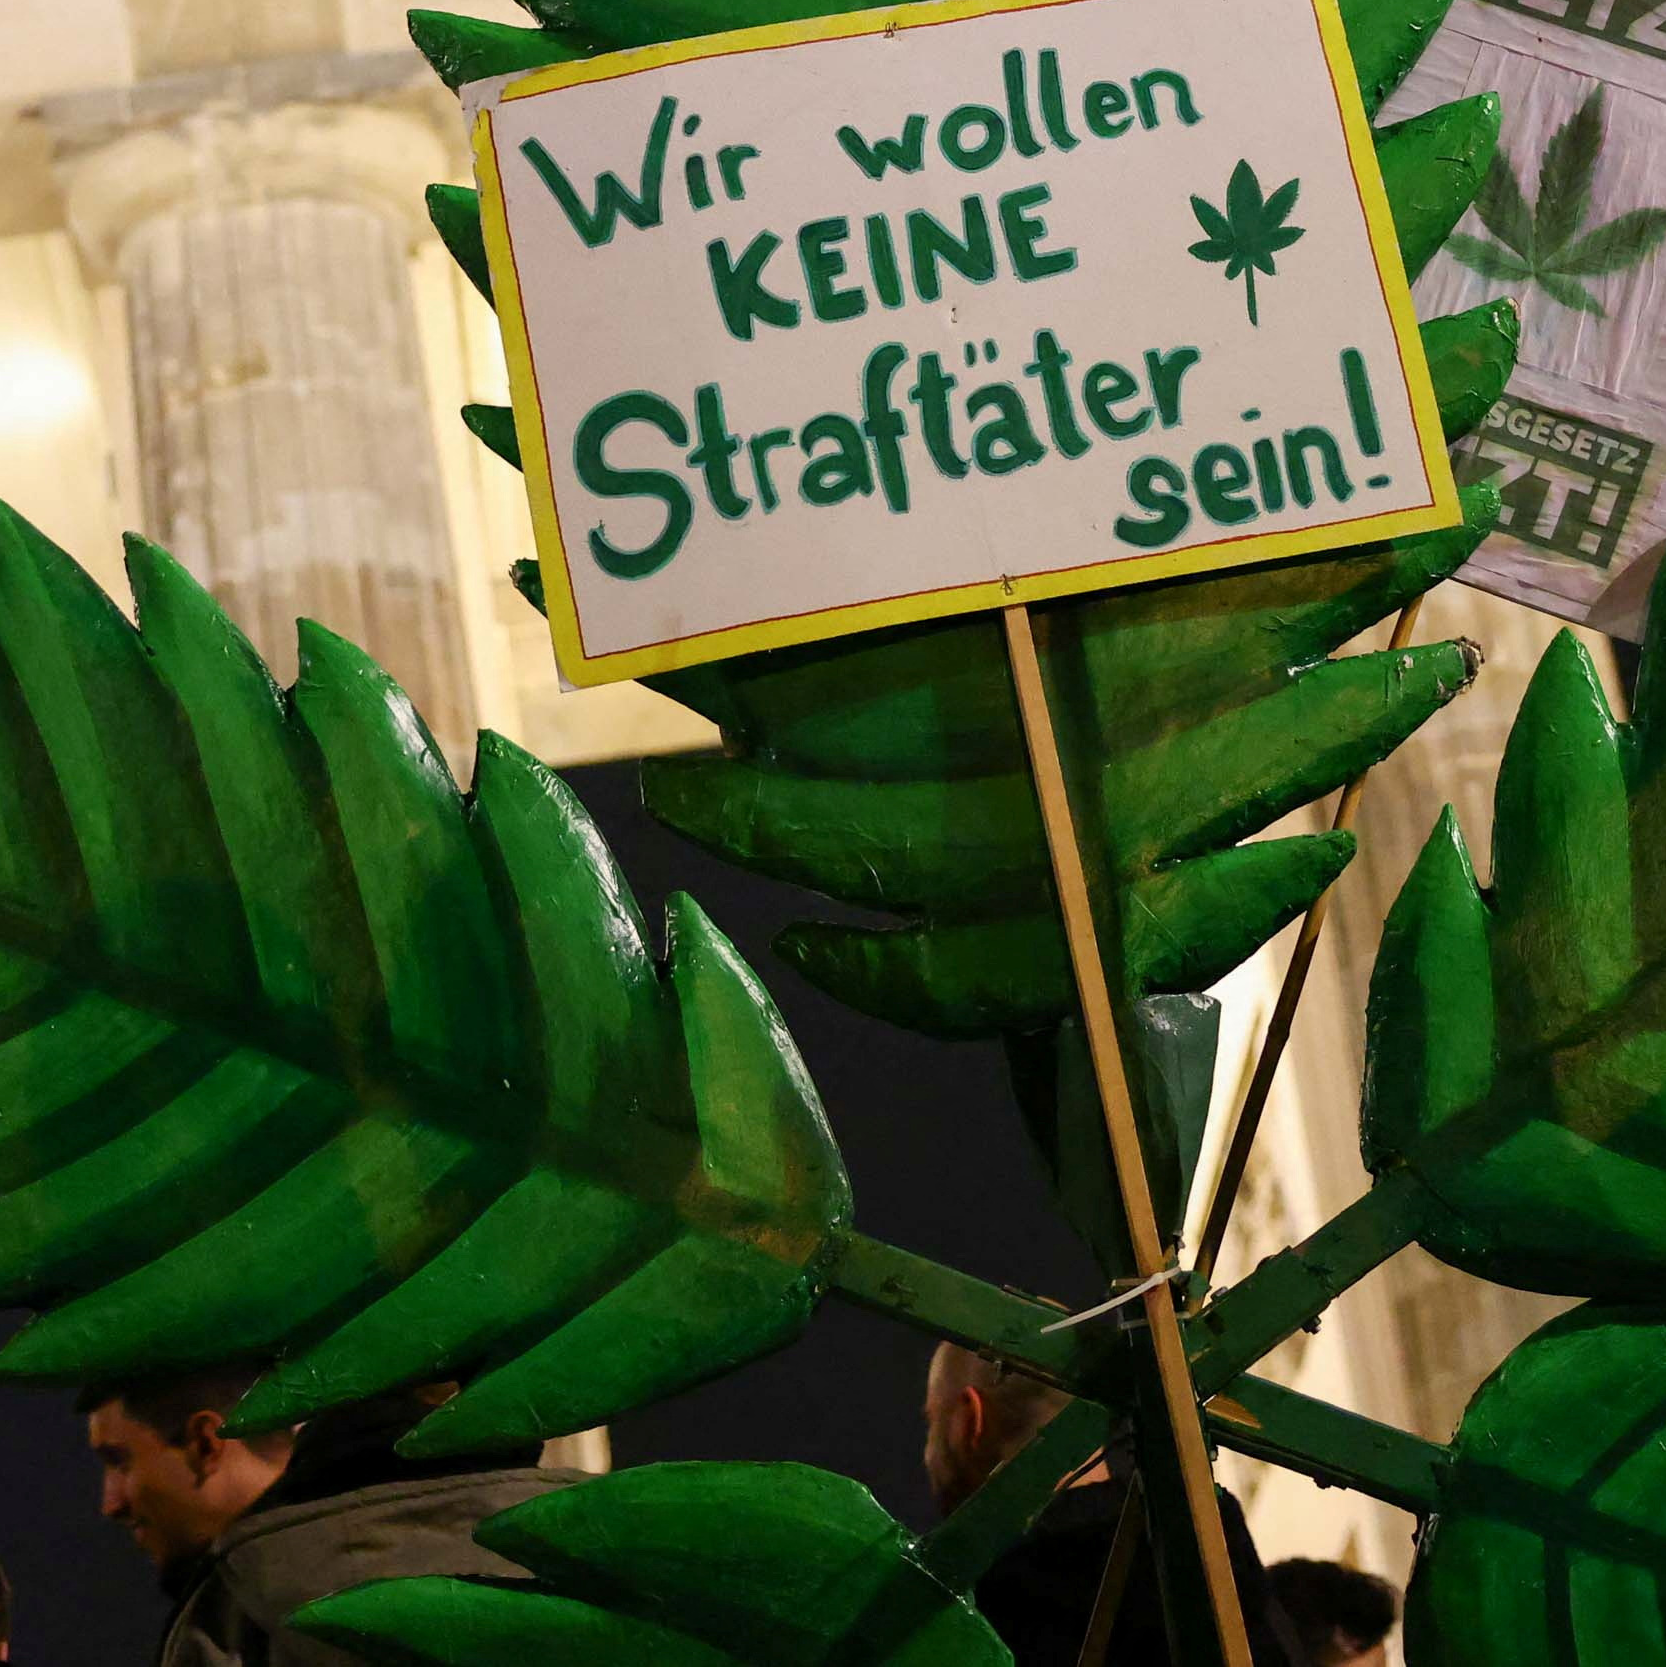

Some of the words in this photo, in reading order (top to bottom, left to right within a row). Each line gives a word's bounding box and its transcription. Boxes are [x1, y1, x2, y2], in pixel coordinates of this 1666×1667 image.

[518, 95, 763, 249] Wir
[834, 47, 1203, 182] wollen
[705, 182, 1079, 342] KEINE
[571, 327, 1201, 582] Straftäter
[1112, 346, 1390, 550] sein!
[1449, 435, 1622, 556] ZT!
[1485, 400, 1641, 475] SGESETZ
